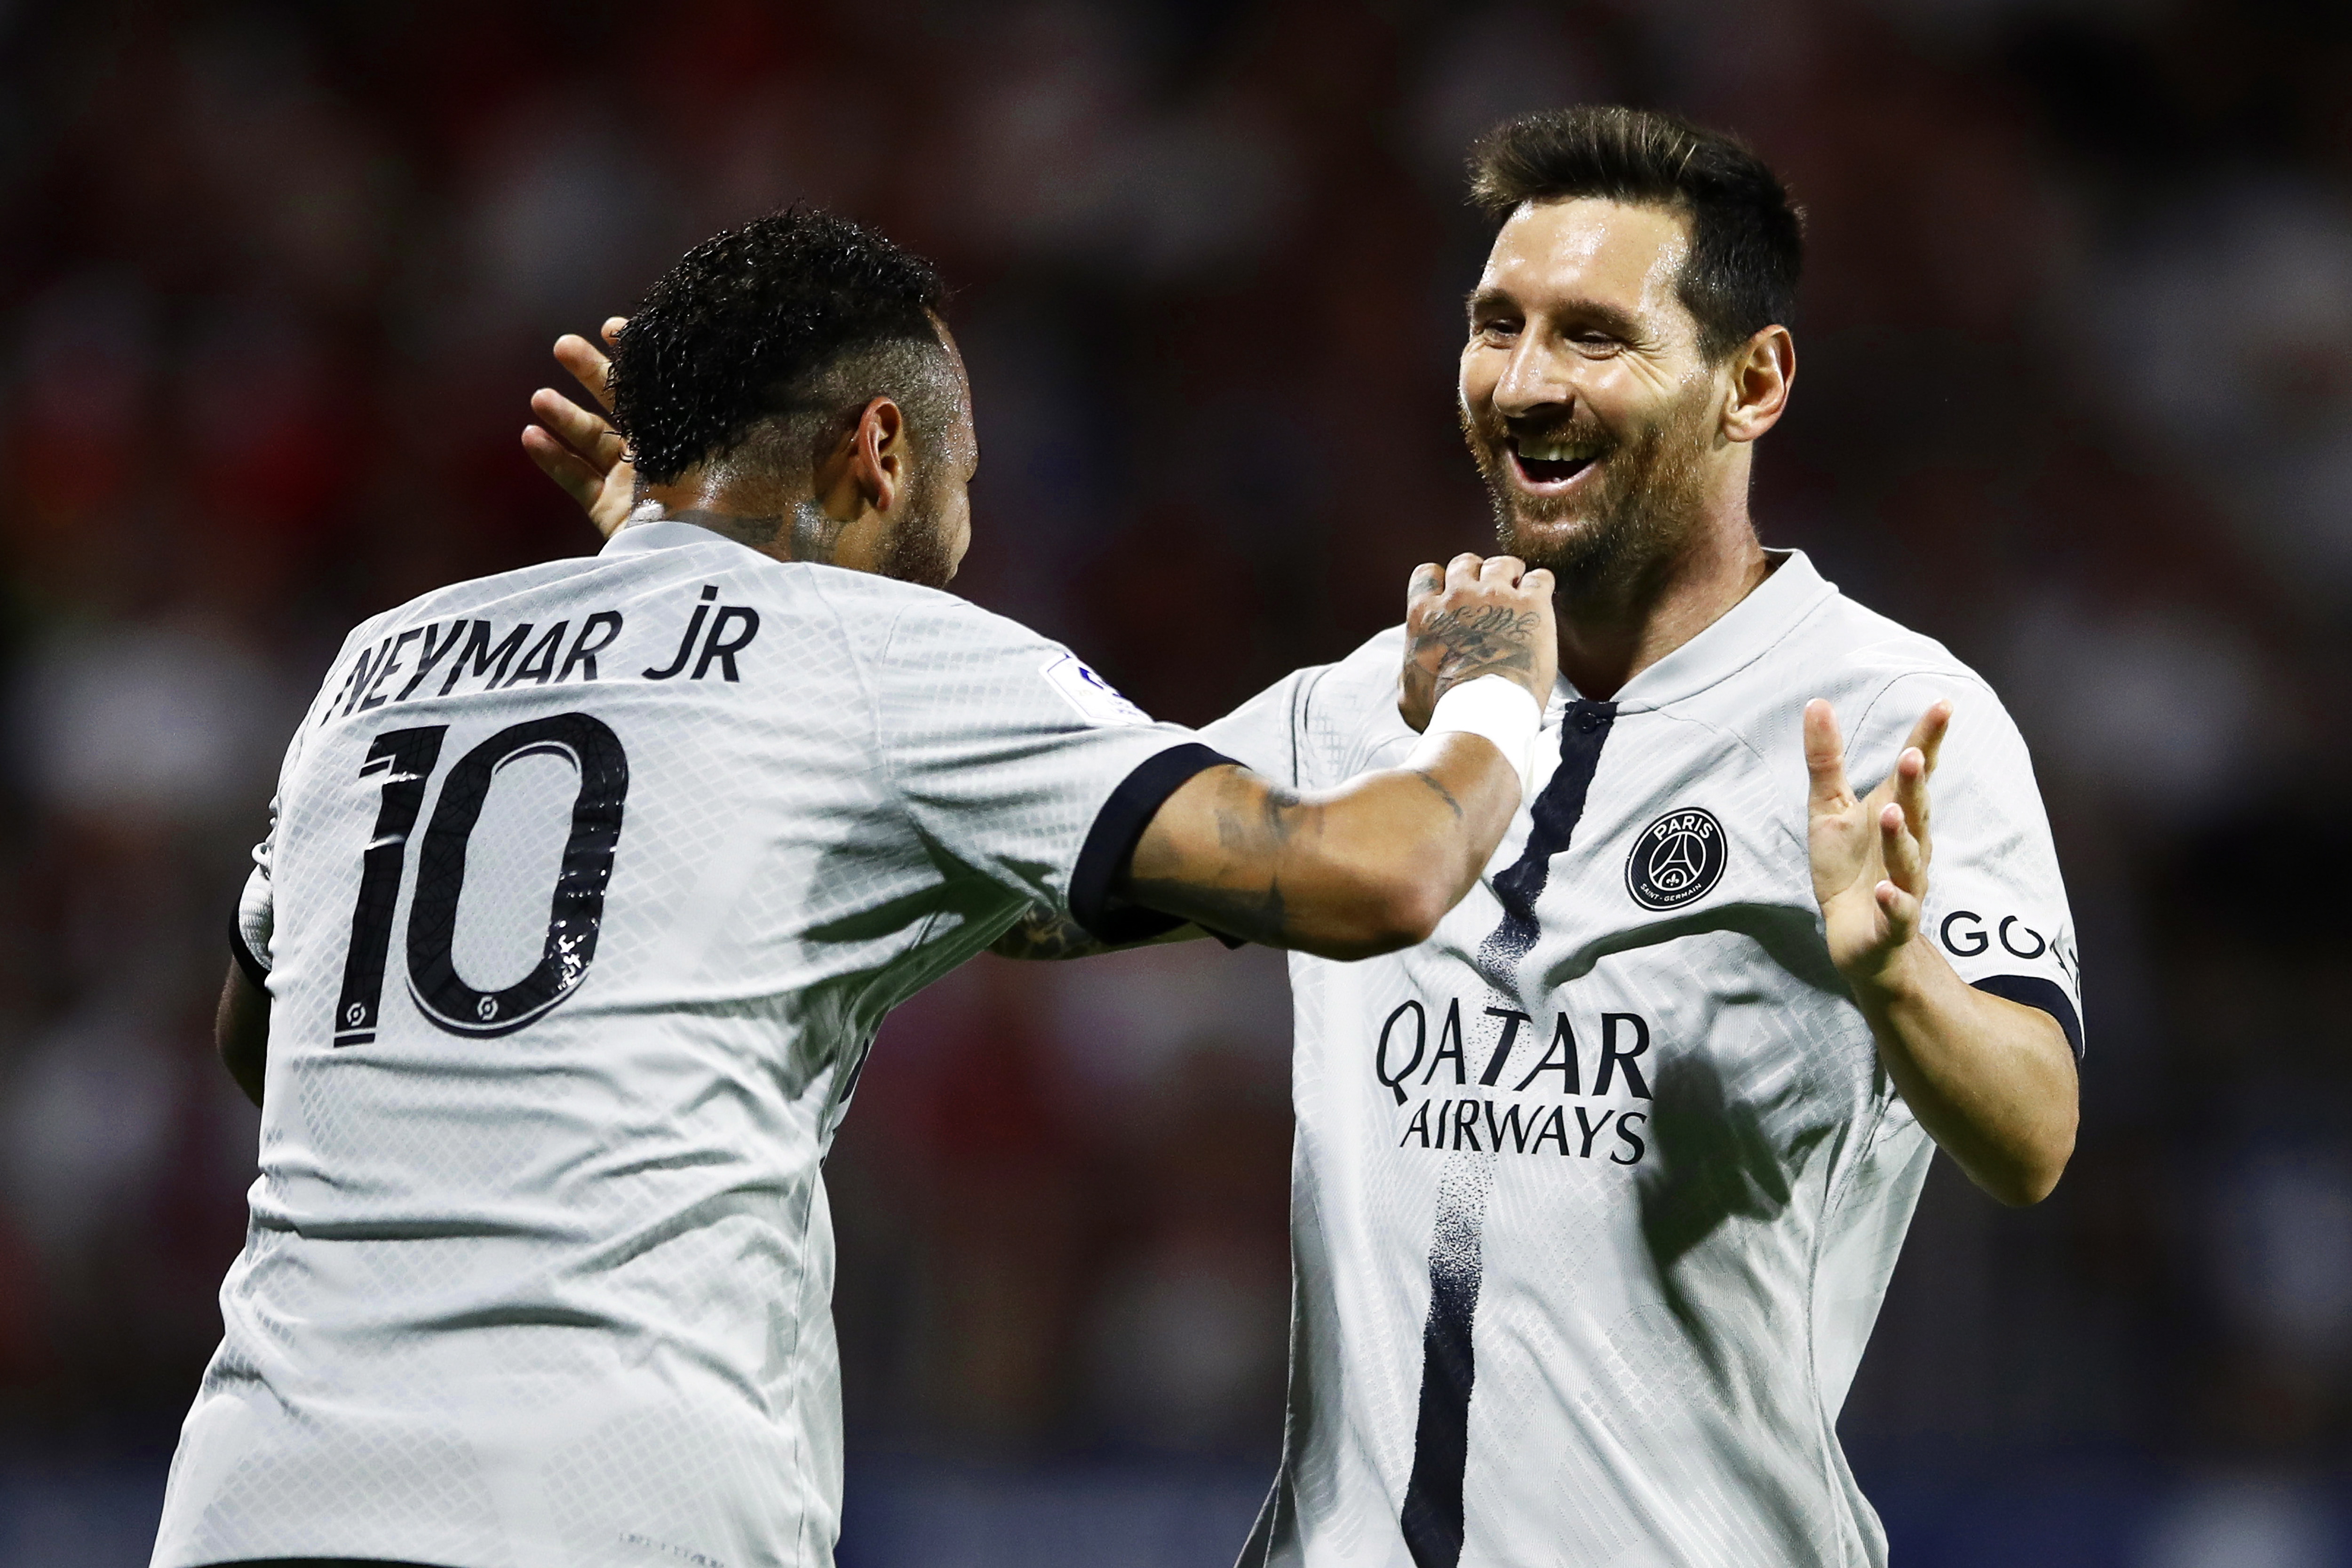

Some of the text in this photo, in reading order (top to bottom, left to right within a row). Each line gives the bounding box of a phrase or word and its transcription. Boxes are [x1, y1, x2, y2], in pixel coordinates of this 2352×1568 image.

[319, 610, 622, 728] NEYMAR
[332, 712, 629, 1048] 10
[1653, 815, 1713, 841] PARIS
[1376, 997, 1653, 1107] QATAR
[1399, 1099, 1647, 1166] AIRWAYS
